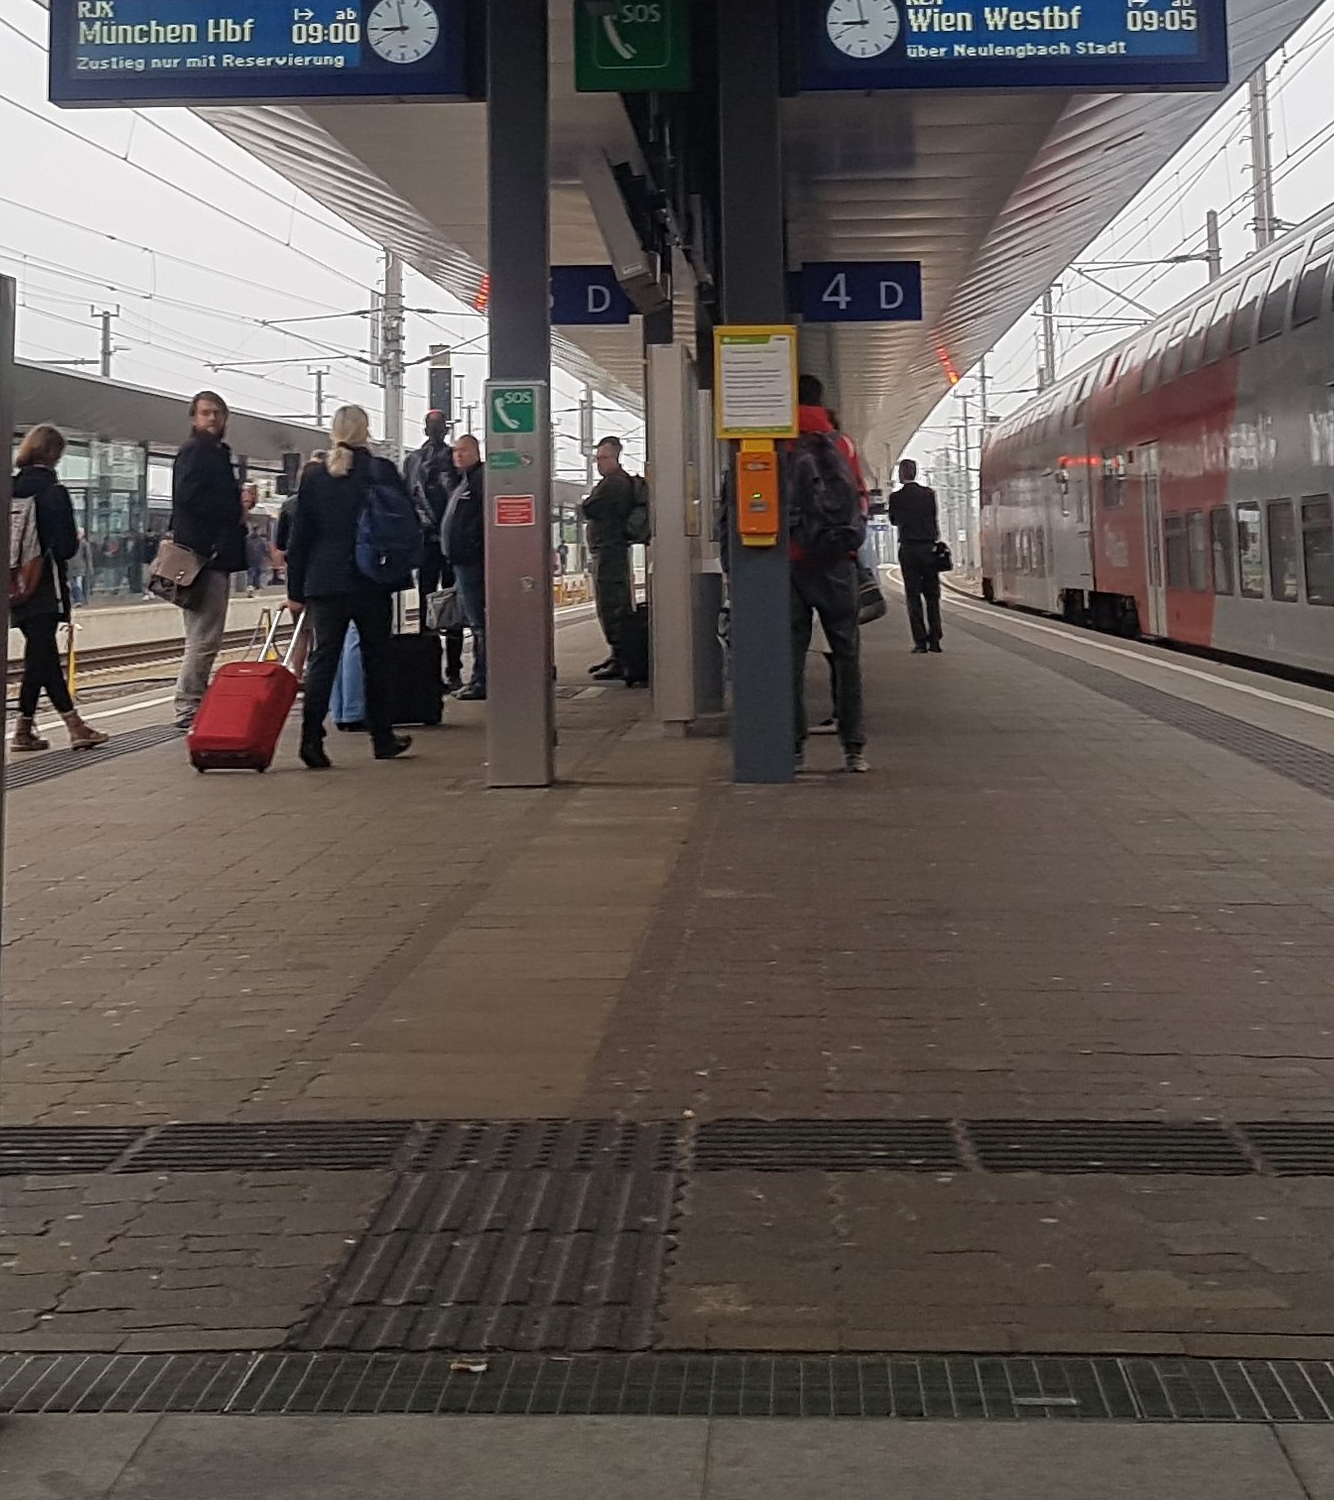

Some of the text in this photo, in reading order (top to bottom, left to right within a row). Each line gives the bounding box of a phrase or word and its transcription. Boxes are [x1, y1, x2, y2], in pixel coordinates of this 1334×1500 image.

[77, 0, 115, 18] RJX
[335, 7, 358, 20] ab
[623, 3, 662, 23] SOS
[907, 5, 1082, 32] Wien Westbf
[1126, 9, 1198, 31] 09:05
[79, 18, 255, 45] München Hbf
[291, 22, 361, 44] 09:00
[906, 41, 1127, 59] über Neulengbach Stadt
[76, 53, 345, 72] Zustieg nur mit Reservierung
[587, 284, 611, 313] D
[822, 272, 904, 310] 4 D
[503, 391, 533, 404] SOS
